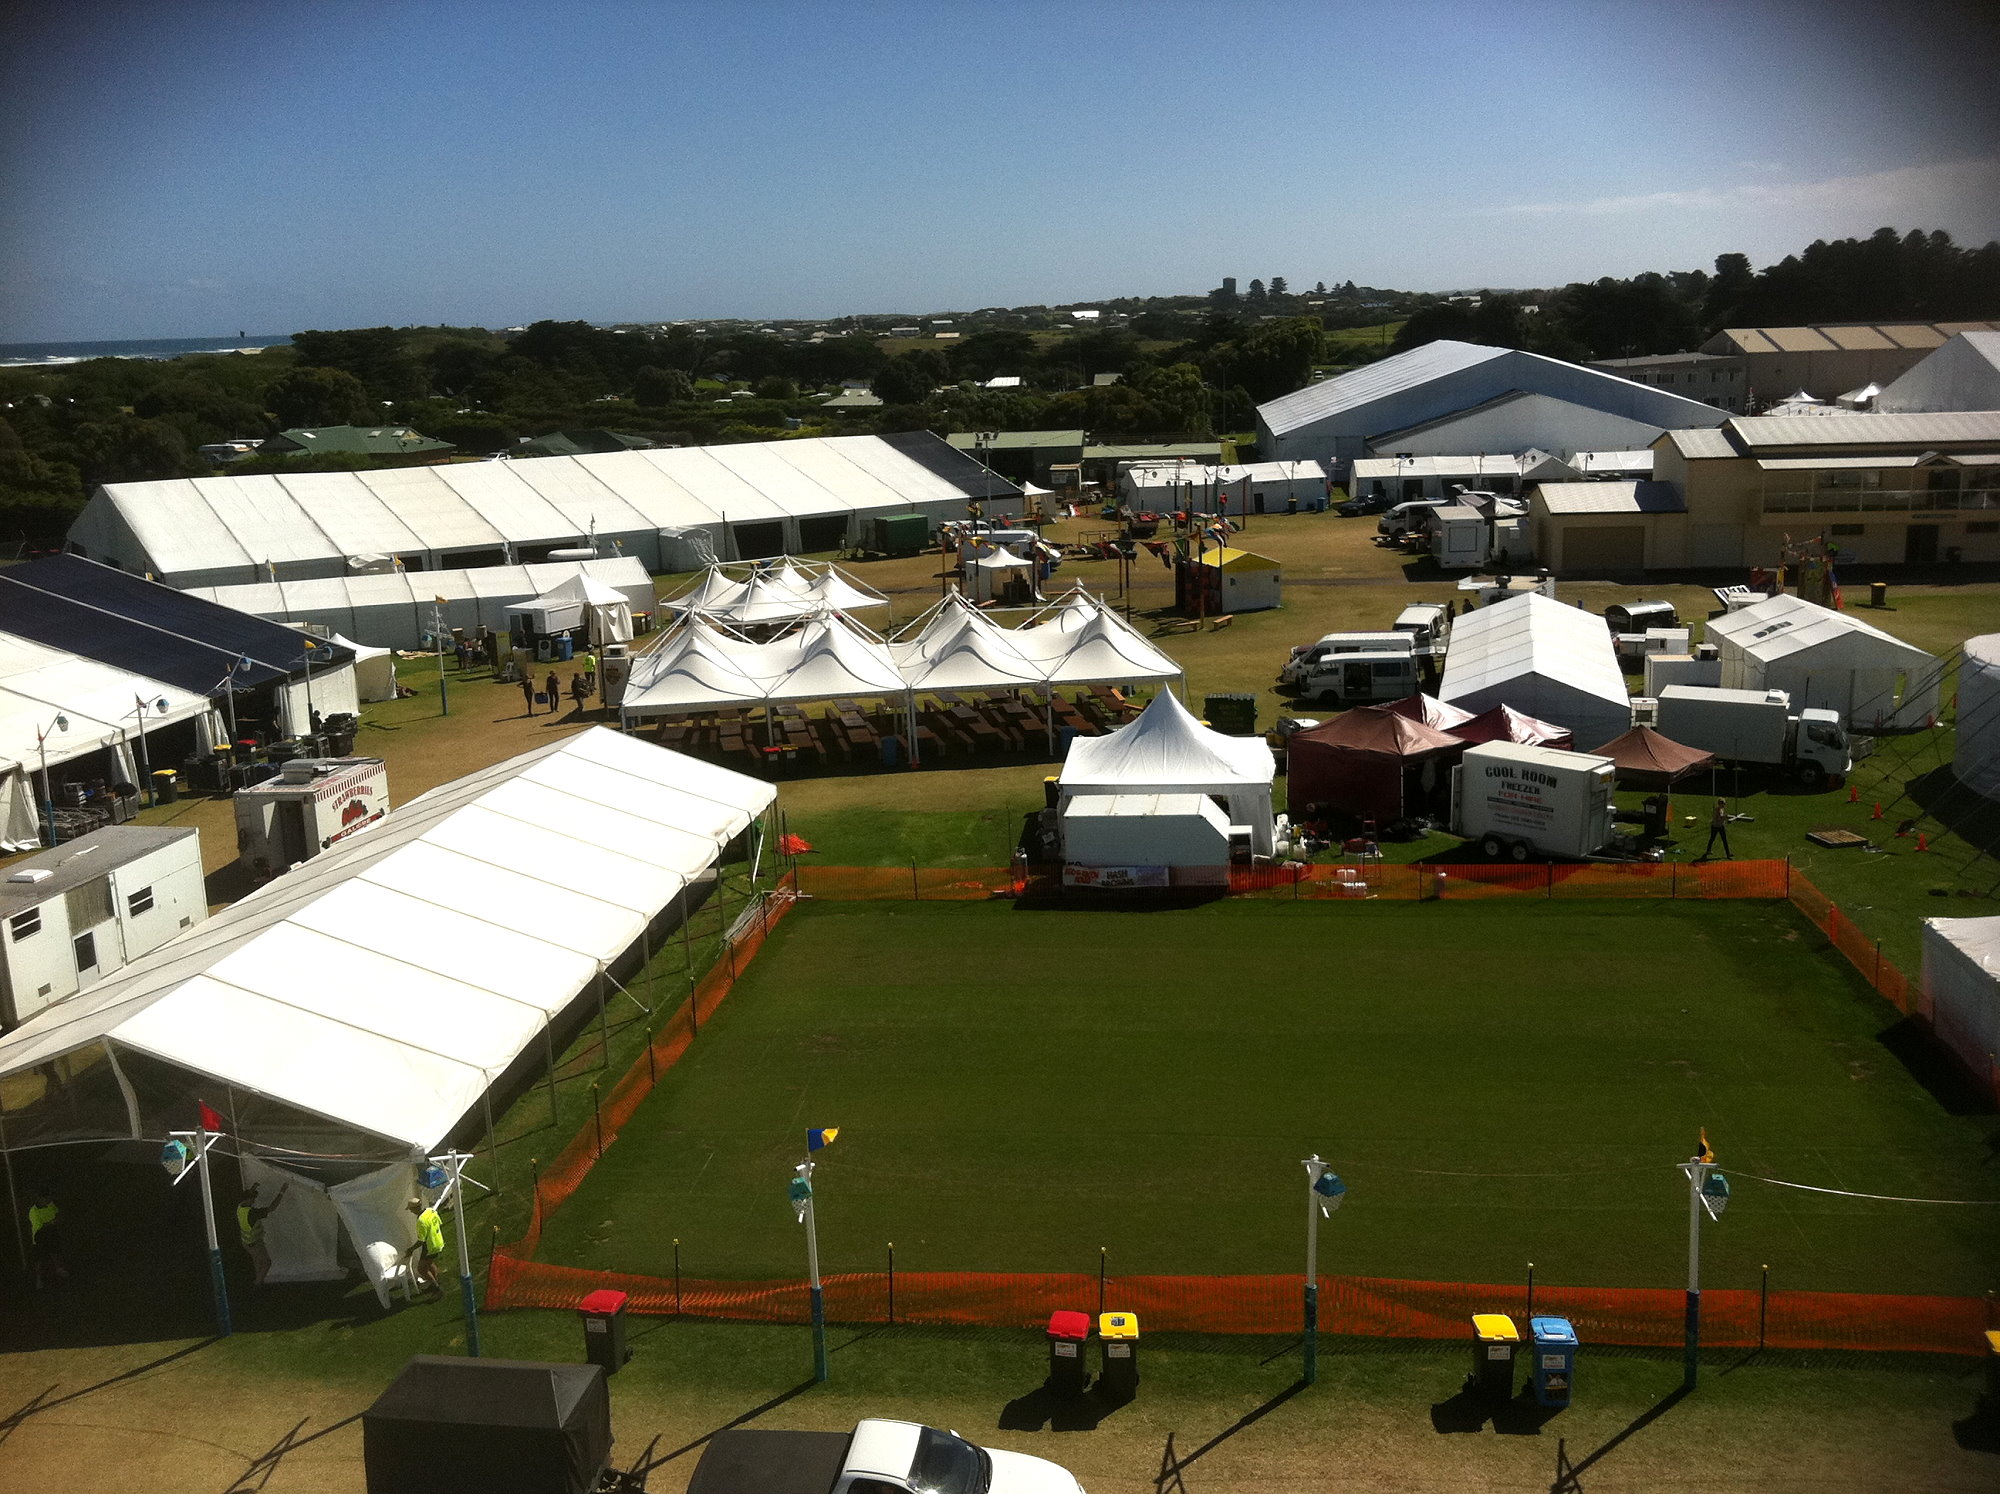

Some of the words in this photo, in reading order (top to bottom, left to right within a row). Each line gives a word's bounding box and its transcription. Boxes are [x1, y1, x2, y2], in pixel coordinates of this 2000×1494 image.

[1485, 767, 1517, 778] COOL
[1521, 769, 1558, 789] ROOM
[1501, 781, 1540, 794] FREEZER
[332, 785, 373, 811] STRAWBERRIES
[340, 818, 371, 837] GALORE
